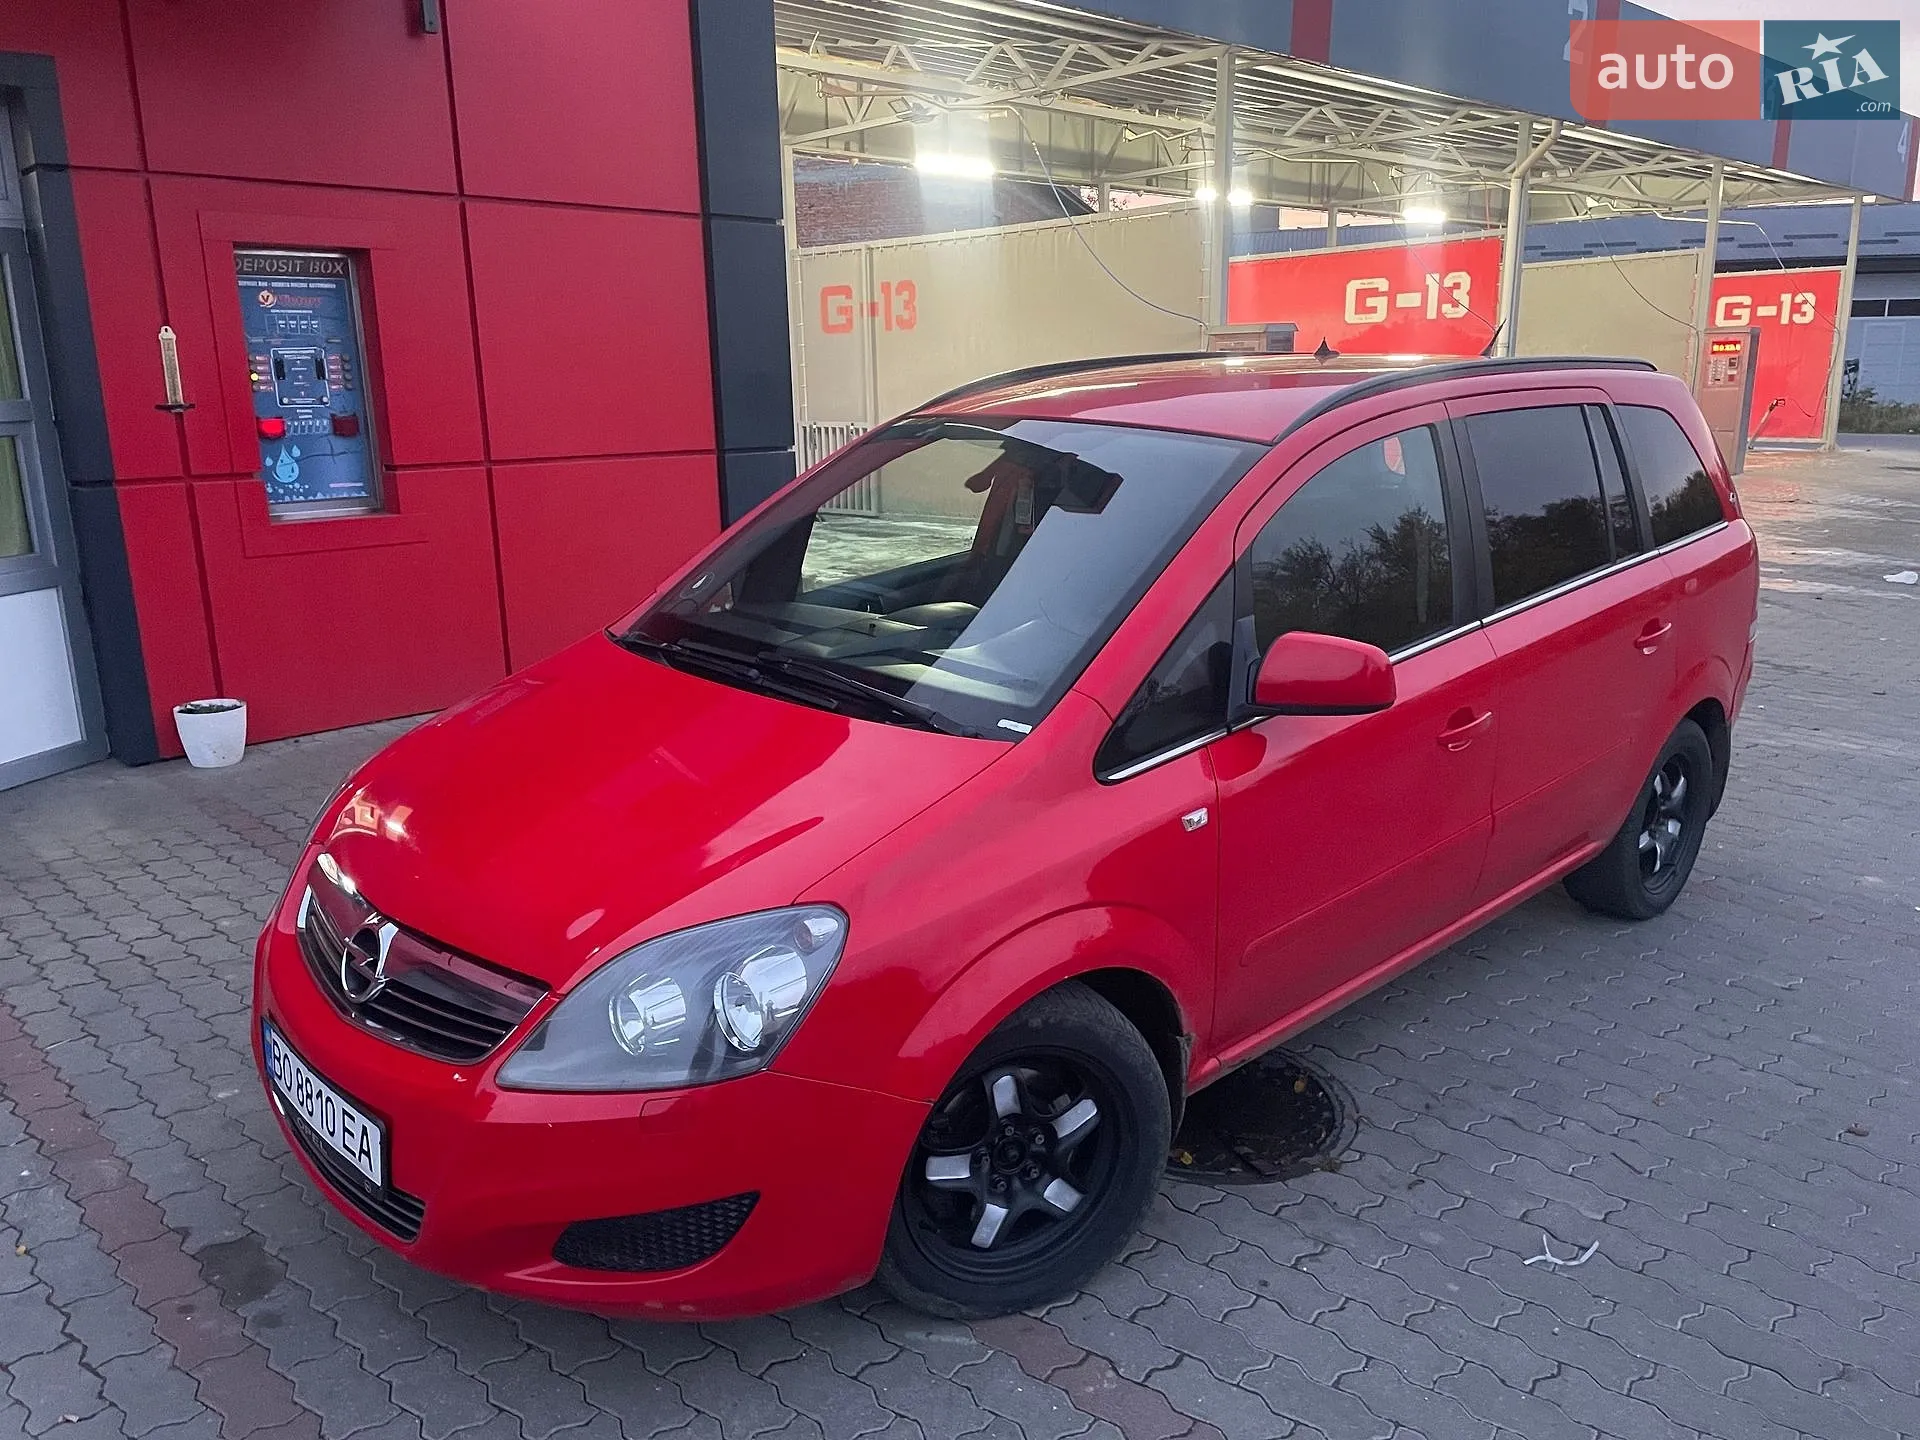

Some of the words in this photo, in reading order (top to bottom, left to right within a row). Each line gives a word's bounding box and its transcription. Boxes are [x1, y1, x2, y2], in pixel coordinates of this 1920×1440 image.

[309, 260, 345, 275] BOX
[820, 280, 917, 334] G-13
[1344, 271, 1472, 325] G-13
[1714, 292, 1817, 328] G-13
[272, 1038, 293, 1093] BO
[295, 1067, 336, 1138] 8810
[342, 1107, 374, 1173] EA
